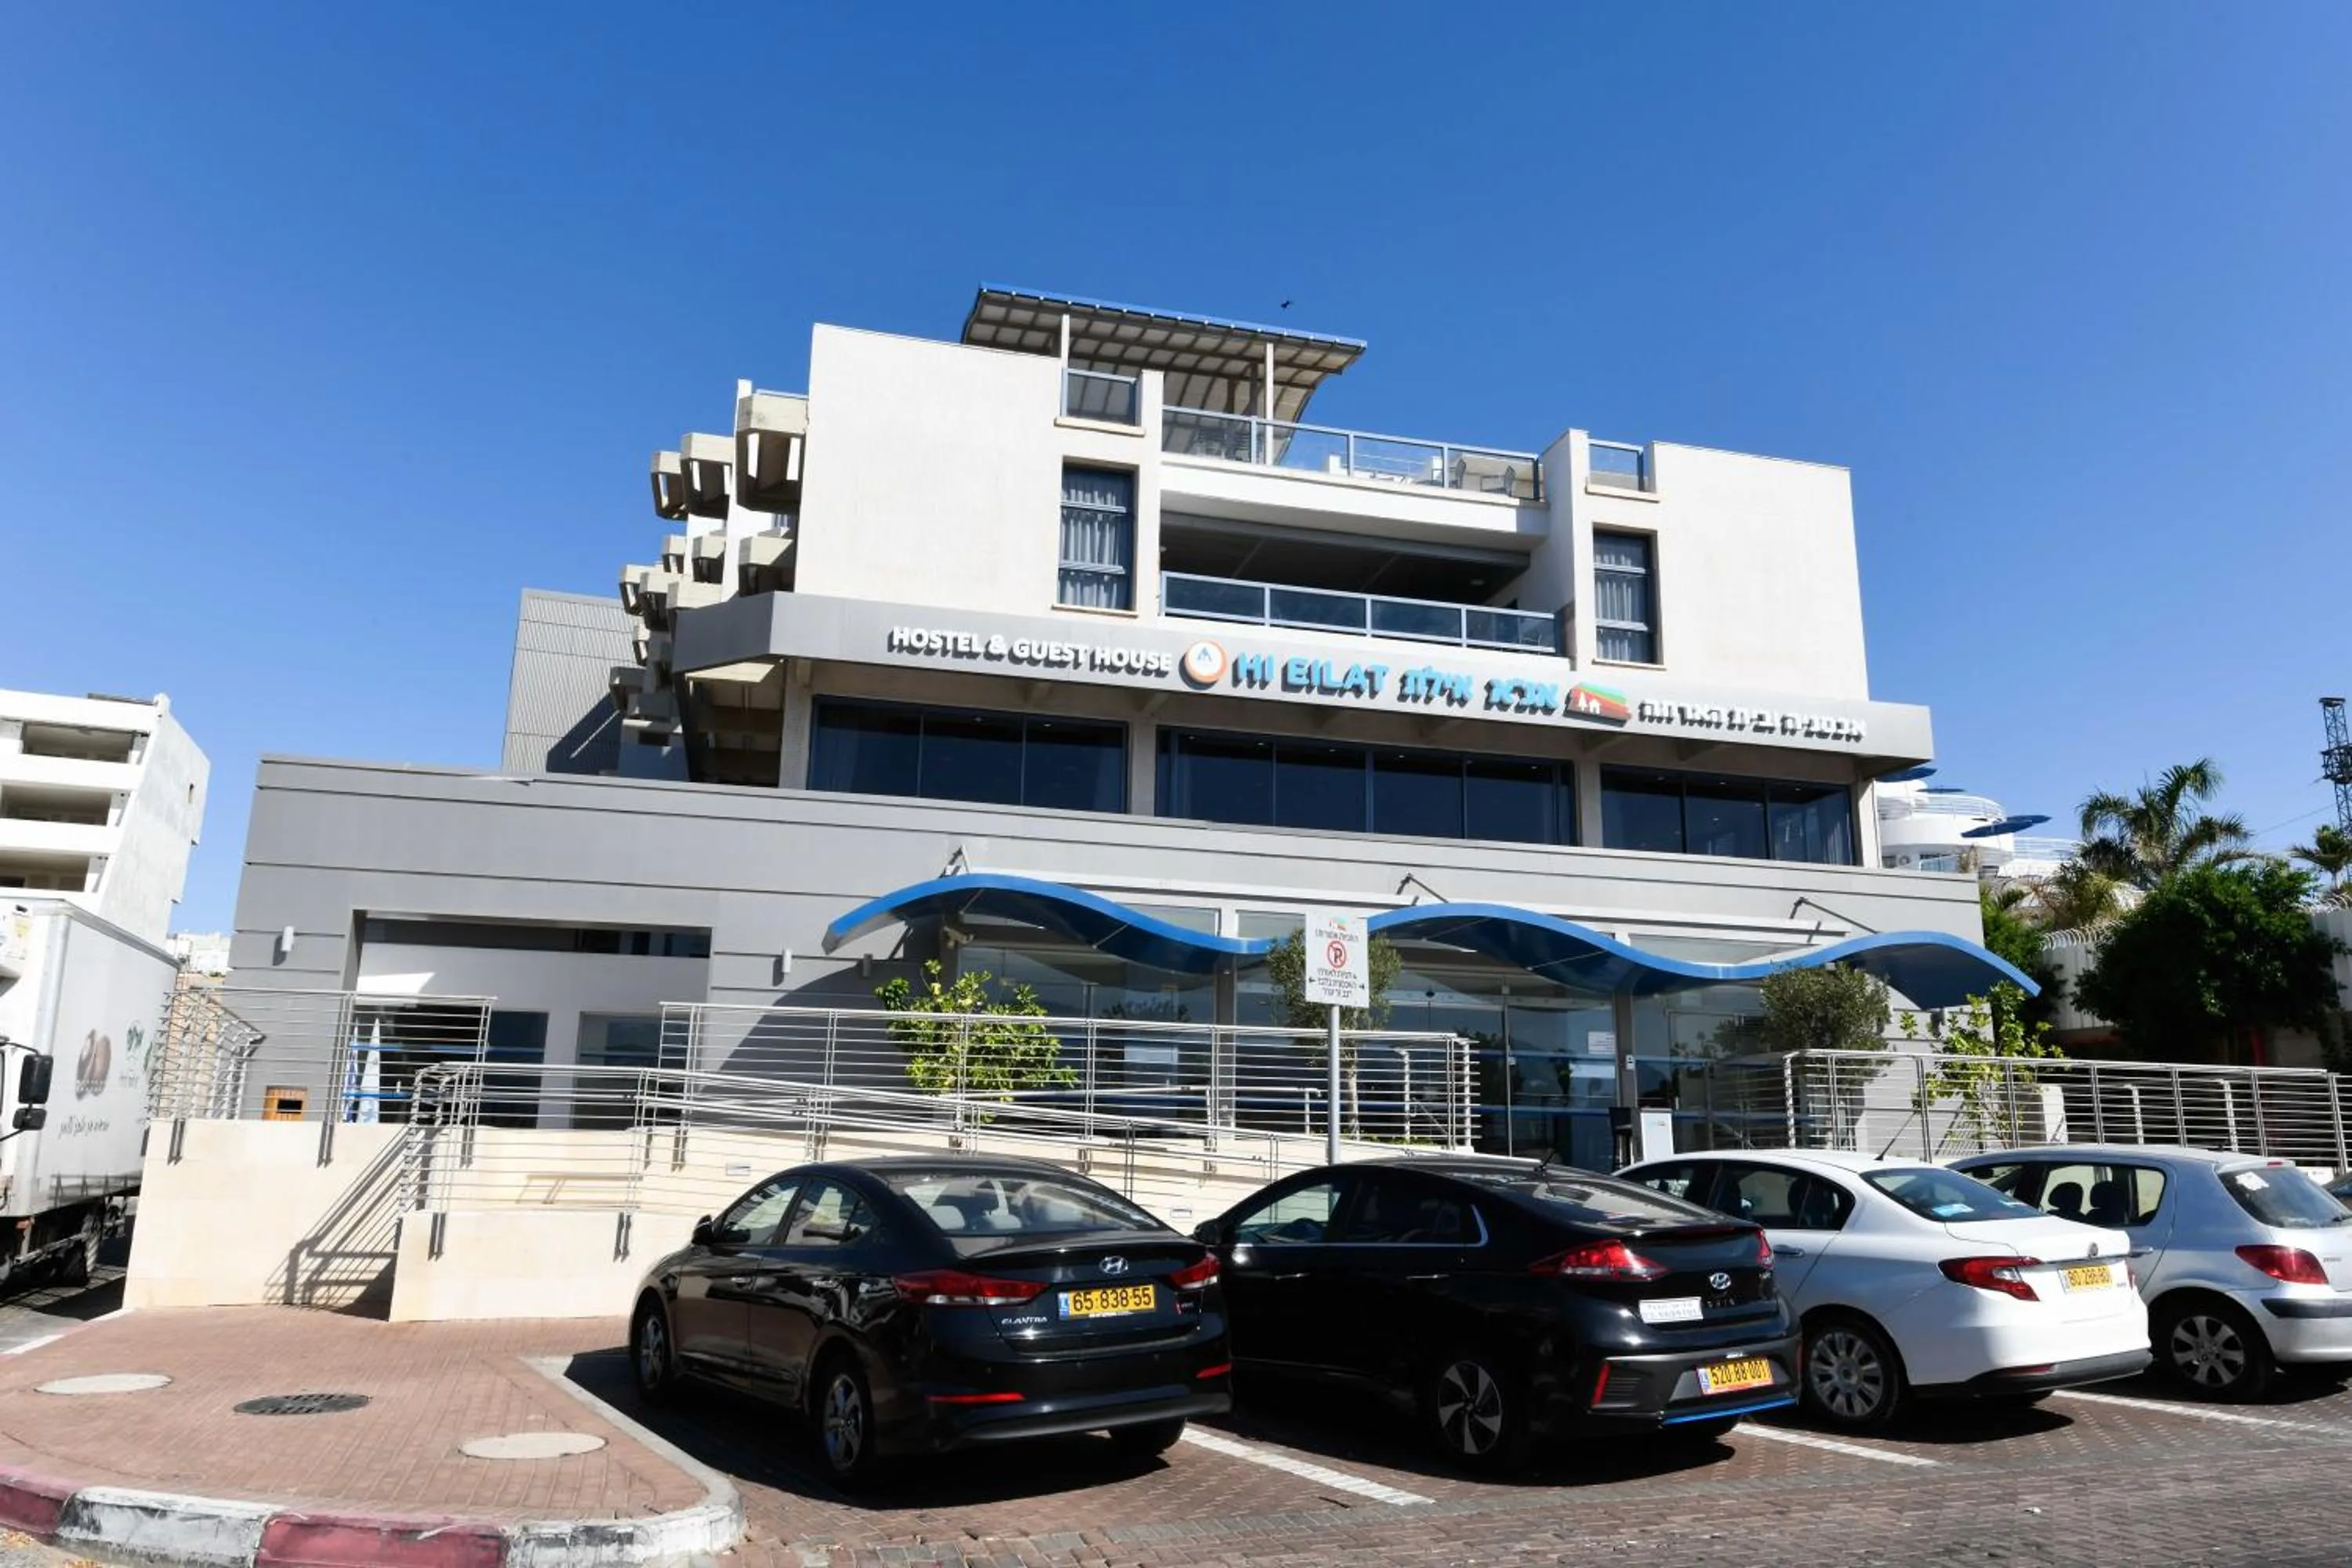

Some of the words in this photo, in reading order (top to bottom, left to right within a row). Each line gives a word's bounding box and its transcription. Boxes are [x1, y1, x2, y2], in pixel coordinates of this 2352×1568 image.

[891, 626, 984, 655] HOSTEL
[987, 633, 1008, 656] &
[1011, 637, 1089, 665] GUEST
[1097, 645, 1174, 673] HOUSE
[1236, 652, 1276, 681] HI
[1285, 655, 1390, 693] EILAT
[1403, 665, 1474, 700] אילת
[1001, 1316, 1048, 1326] ELANTRA
